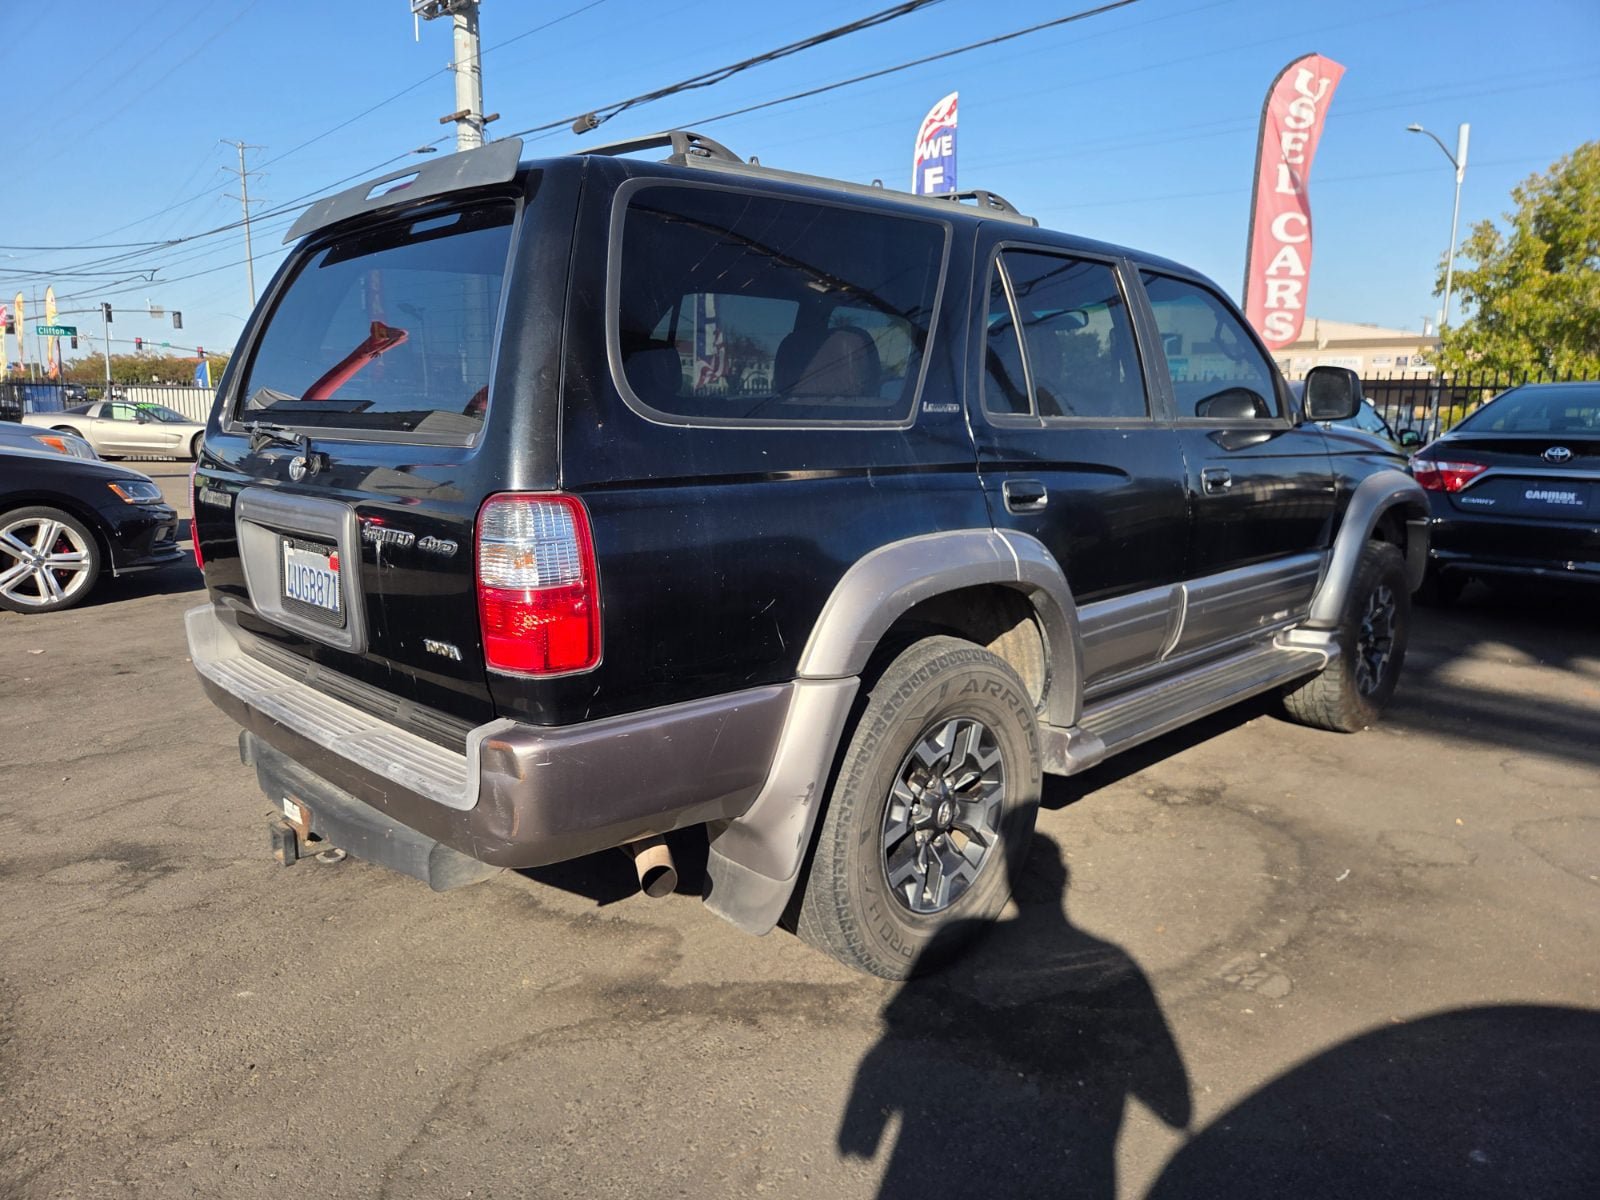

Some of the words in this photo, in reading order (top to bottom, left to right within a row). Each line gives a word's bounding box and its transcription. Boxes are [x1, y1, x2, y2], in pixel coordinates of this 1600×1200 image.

[922, 135, 952, 160] WE
[1275, 68, 1331, 195] USED
[1262, 212, 1308, 342] CARS
[38, 327, 65, 335] Clifton
[287, 563, 339, 614] 4UGB871
